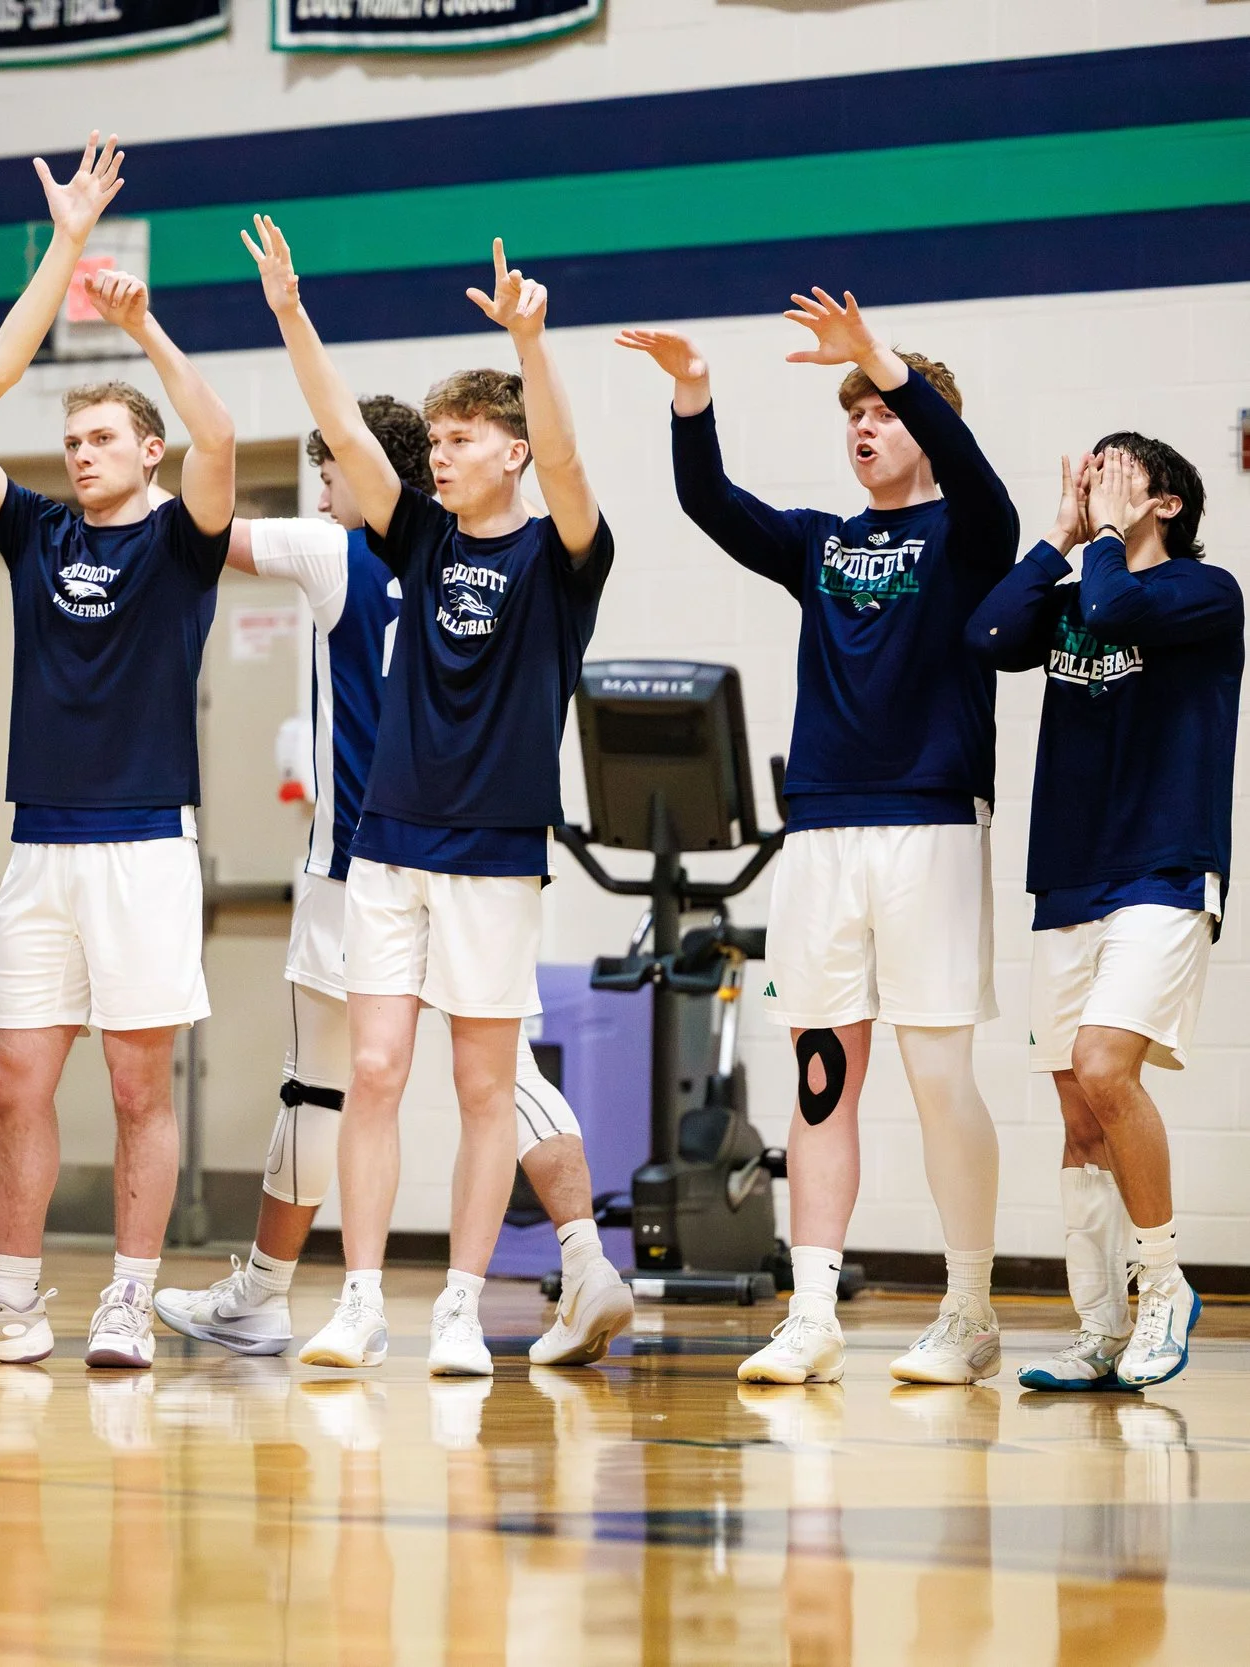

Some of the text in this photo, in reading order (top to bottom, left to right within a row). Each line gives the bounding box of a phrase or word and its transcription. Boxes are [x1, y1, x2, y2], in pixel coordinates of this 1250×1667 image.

[823, 537, 925, 581] ENDICOTT
[442, 562, 508, 593] EDICOTT
[820, 566, 920, 592] VOLEYBALL
[436, 606, 499, 636] VLLEBAL
[1049, 645, 1144, 680] VOLLEBALL
[601, 679, 694, 693] MATRIX
